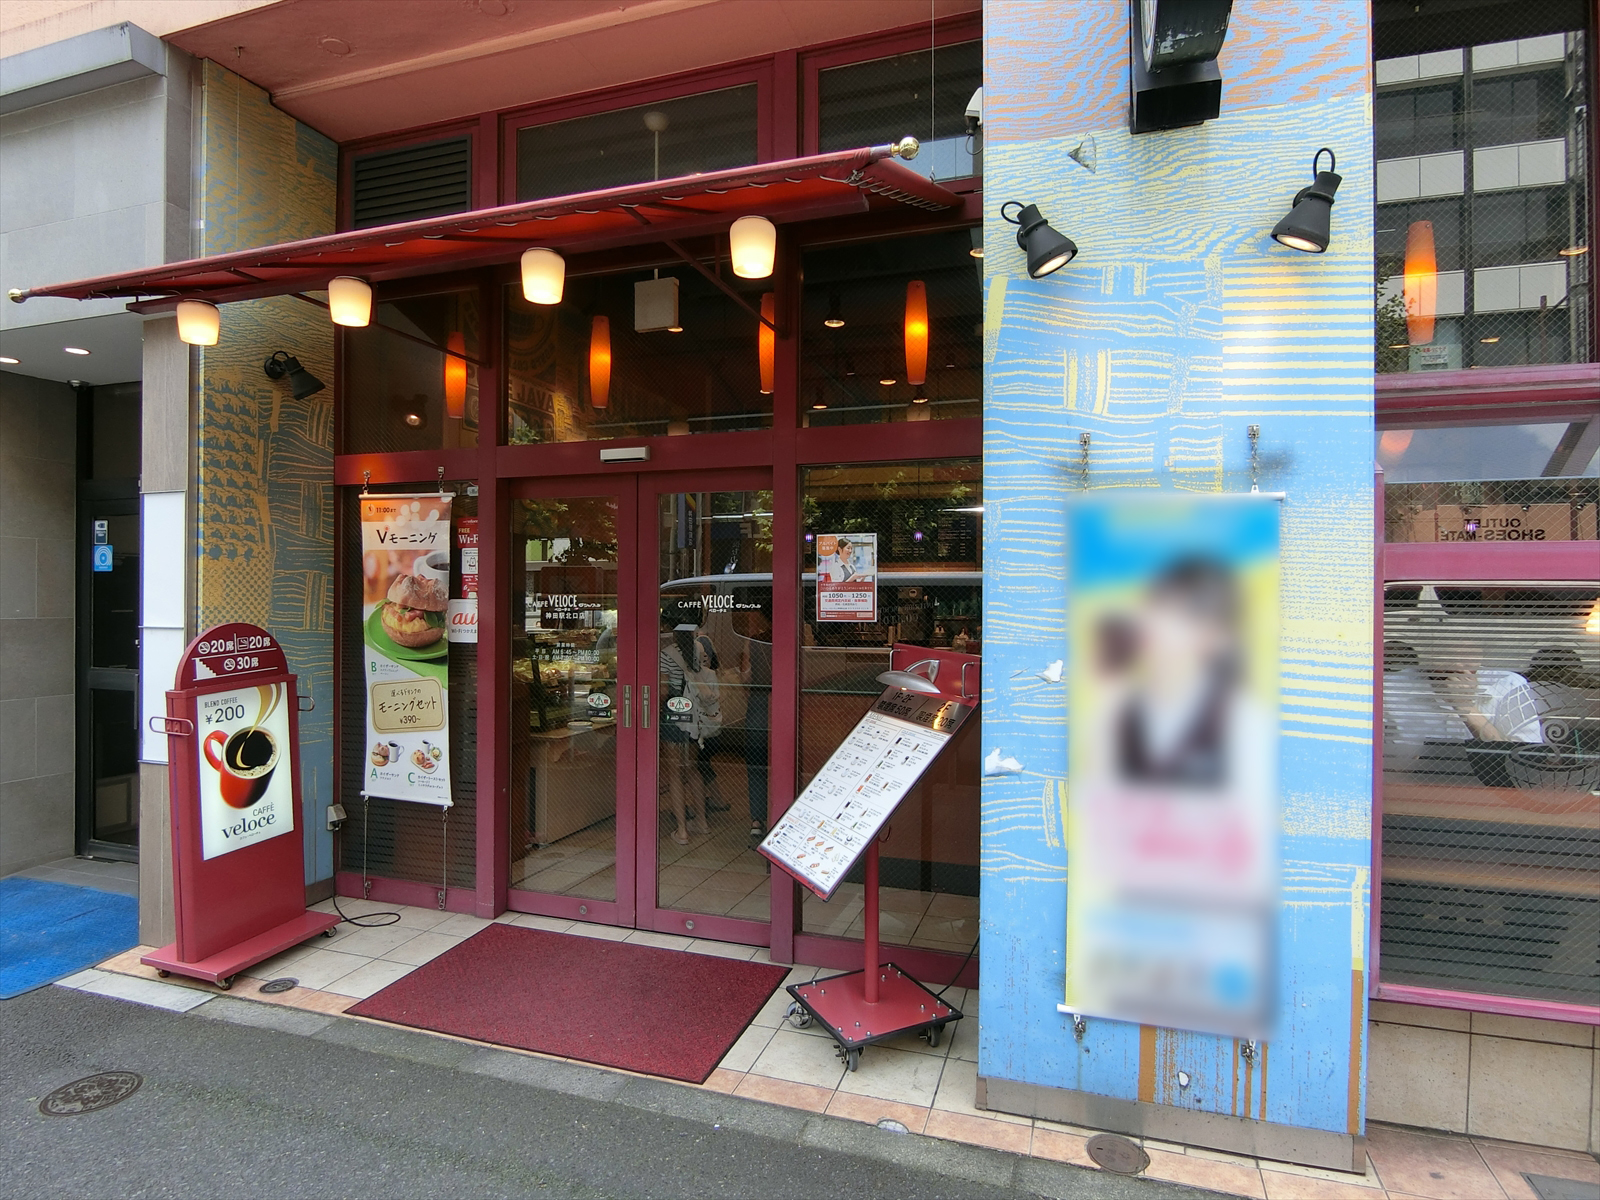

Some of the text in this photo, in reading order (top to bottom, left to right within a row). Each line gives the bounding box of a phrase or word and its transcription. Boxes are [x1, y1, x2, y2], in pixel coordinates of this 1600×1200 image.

[548, 594, 578, 608] VELOCE
[701, 595, 735, 608] VELOCE
[452, 612, 479, 625] au
[371, 661, 377, 672] B
[204, 697, 238, 709] BLEND COFFEE
[378, 696, 437, 713] モーニングセット
[937, 703, 952, 713] 2F
[205, 704, 245, 724] ¥200
[370, 767, 378, 779] A
[408, 772, 416, 784] C
[253, 802, 275, 816] CAFFÈ
[221, 813, 277, 838] veloce
